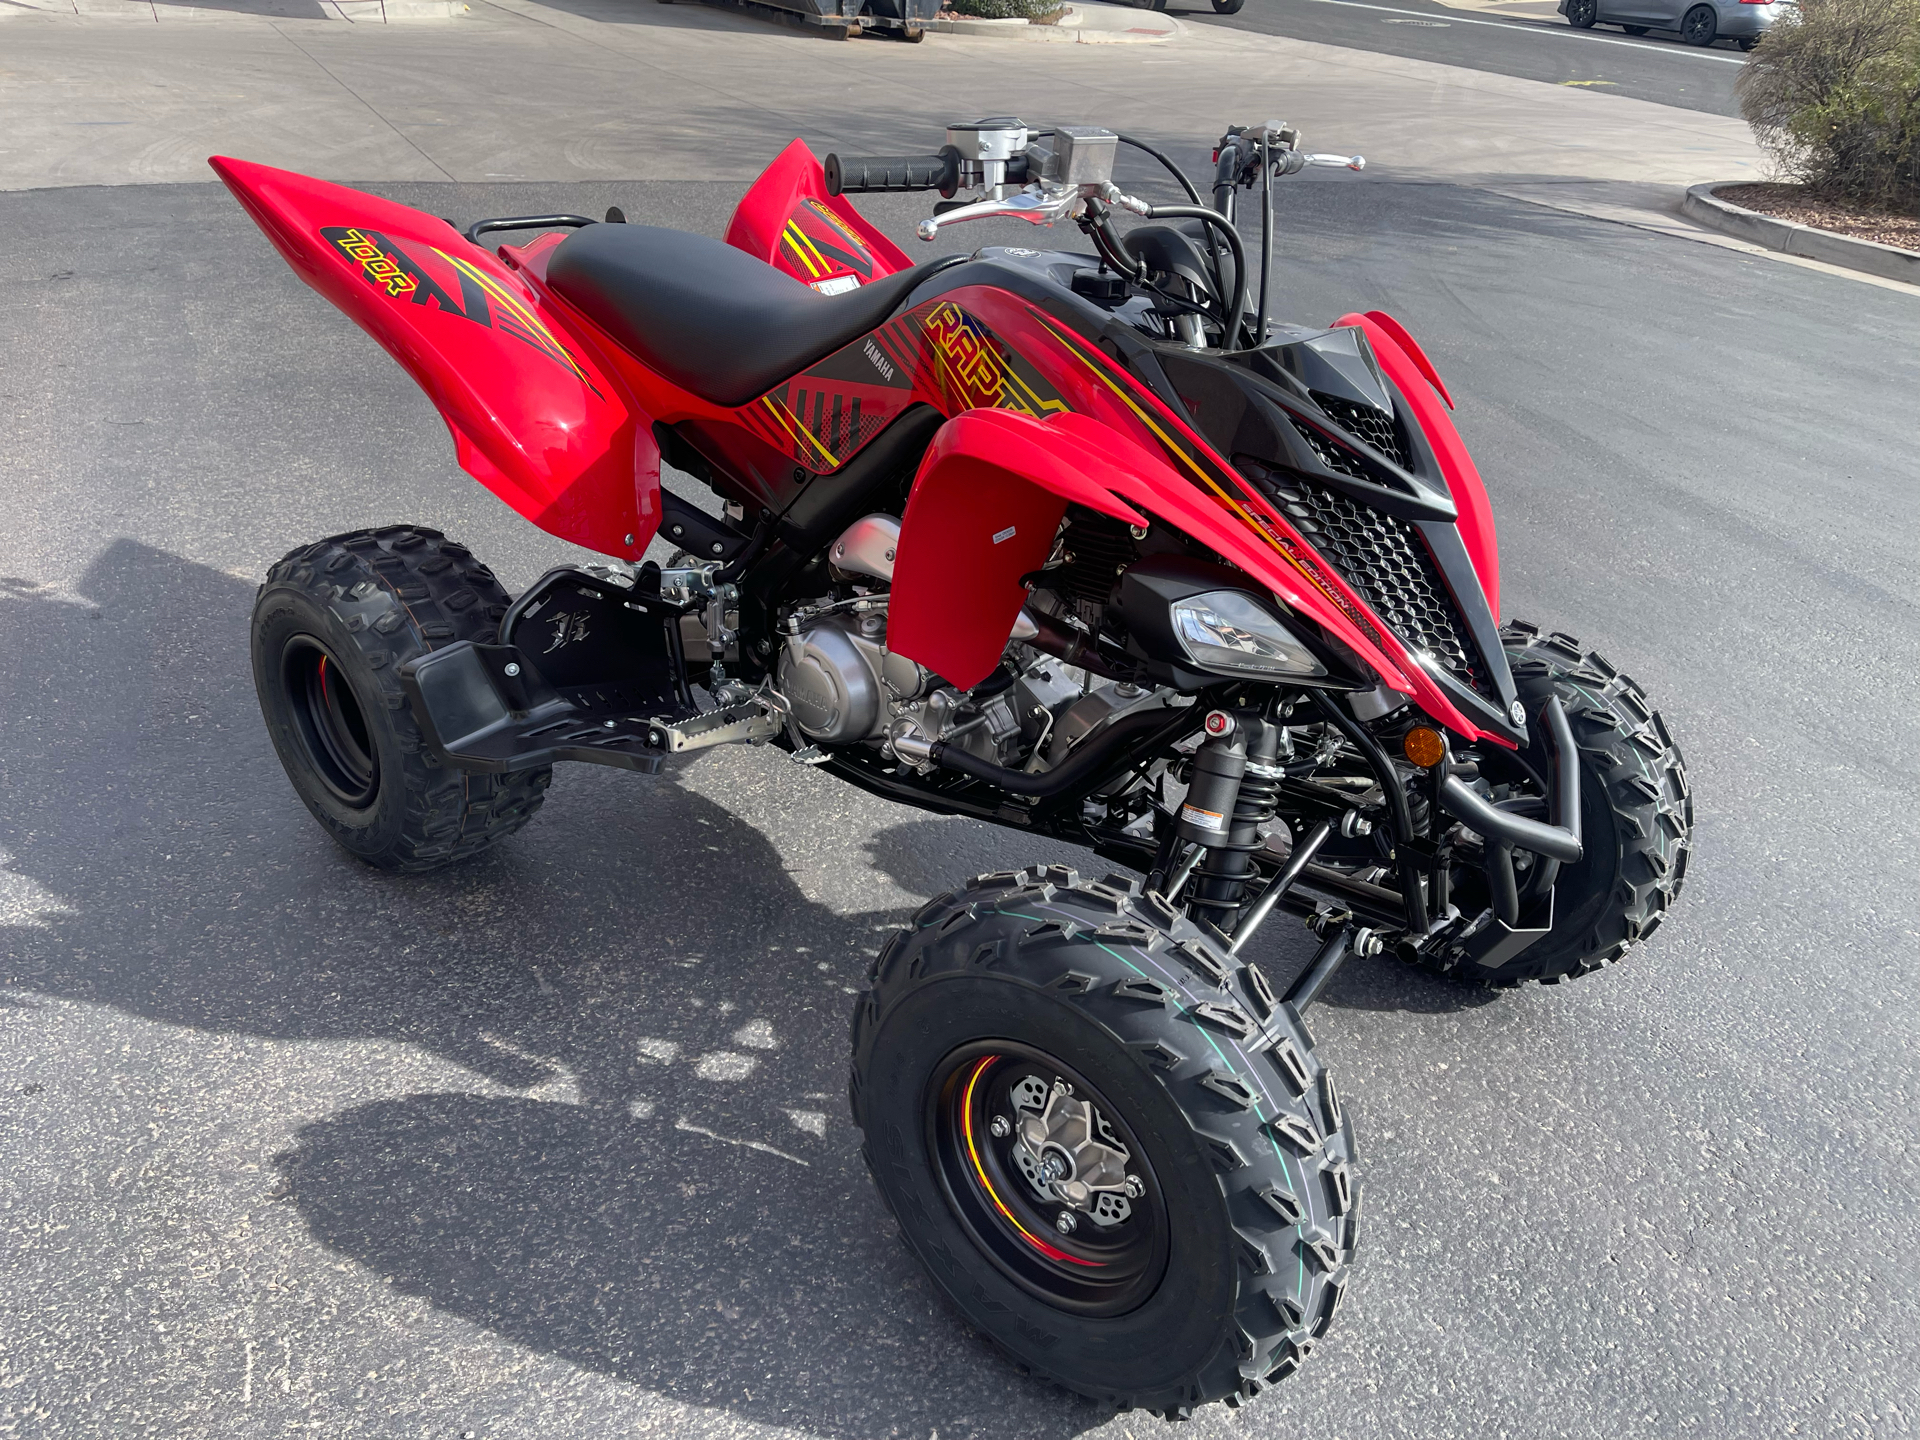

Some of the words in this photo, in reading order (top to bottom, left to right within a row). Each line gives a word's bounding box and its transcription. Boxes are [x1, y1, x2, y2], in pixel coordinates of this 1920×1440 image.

[337, 228, 416, 296] 700R
[863, 338, 894, 382] YAMAHA
[1241, 503, 1297, 559] SPECIAL
[1298, 559, 1349, 609] EDITION
[883, 1119, 1062, 1349] MAXXIS
